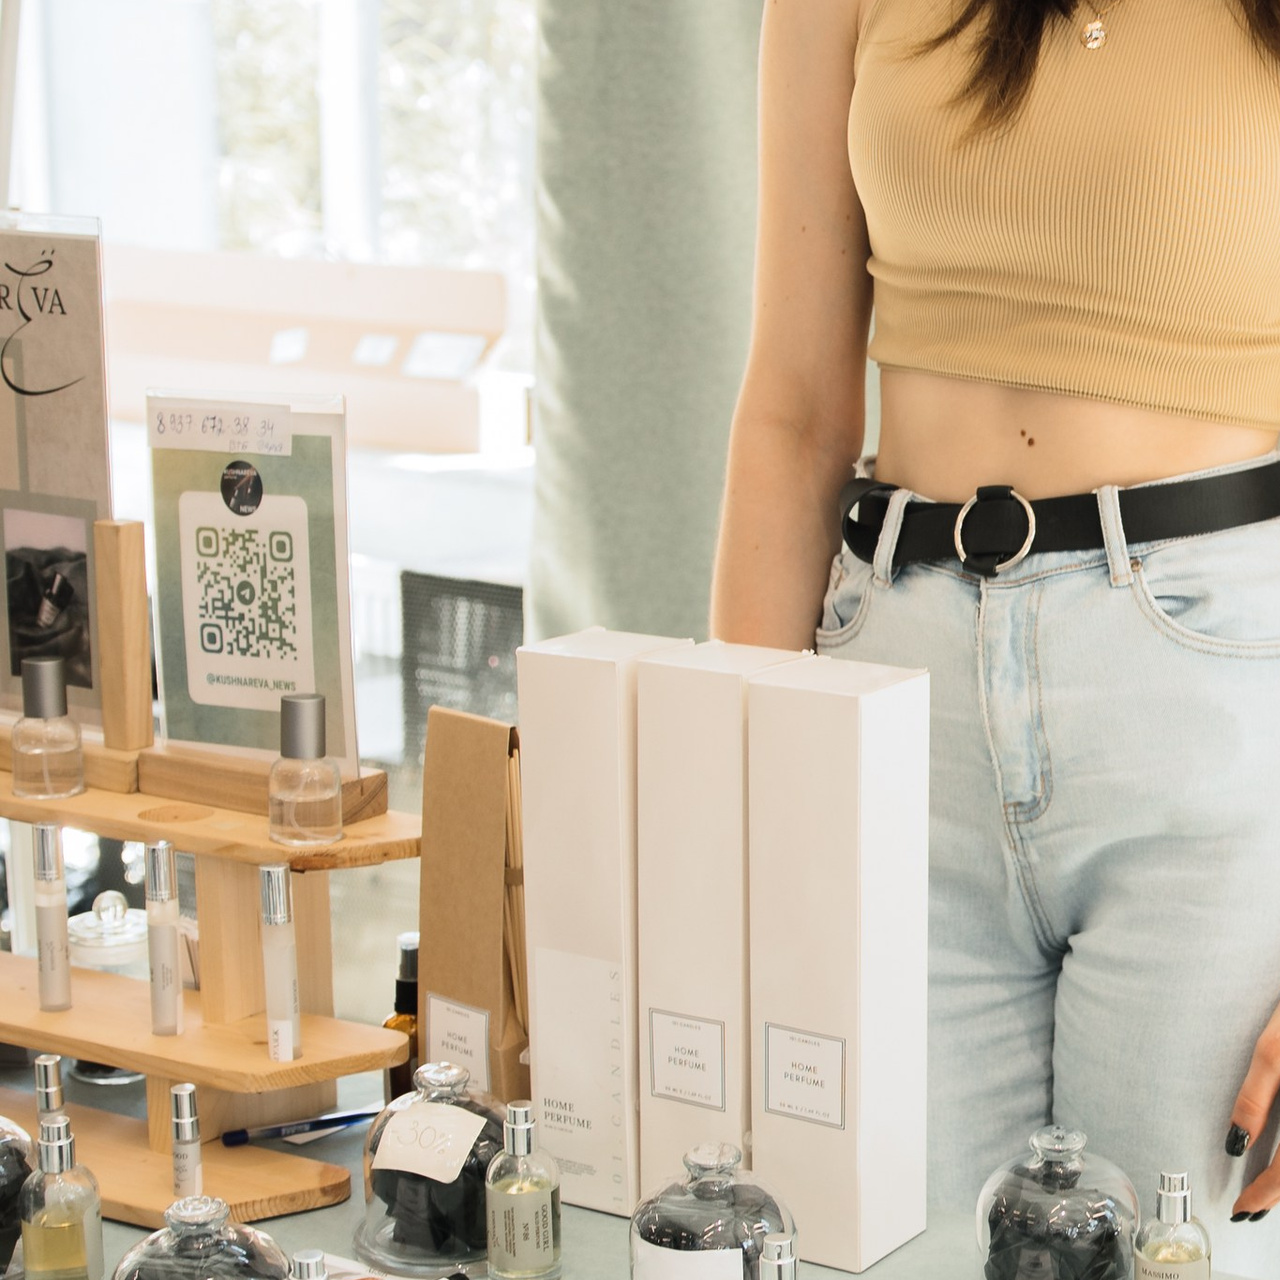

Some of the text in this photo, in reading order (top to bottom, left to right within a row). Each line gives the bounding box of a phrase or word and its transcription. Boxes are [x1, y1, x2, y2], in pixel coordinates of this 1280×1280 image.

[206, 672, 296, 692] @KUSHNAREVA_NEWS
[446, 1028, 468, 1044] HOME
[441, 1039, 474, 1058] PERFUME
[674, 1045, 700, 1059] HOME
[667, 1055, 707, 1073] PERFUME
[791, 1060, 818, 1076] HOME
[783, 1071, 825, 1090] PERFUME
[543, 1097, 575, 1114] HOME
[543, 1111, 593, 1131] PERFUME
[541, 1203, 550, 1253] GOOD GIRL
[1141, 1267, 1180, 1280] MASSIMO
